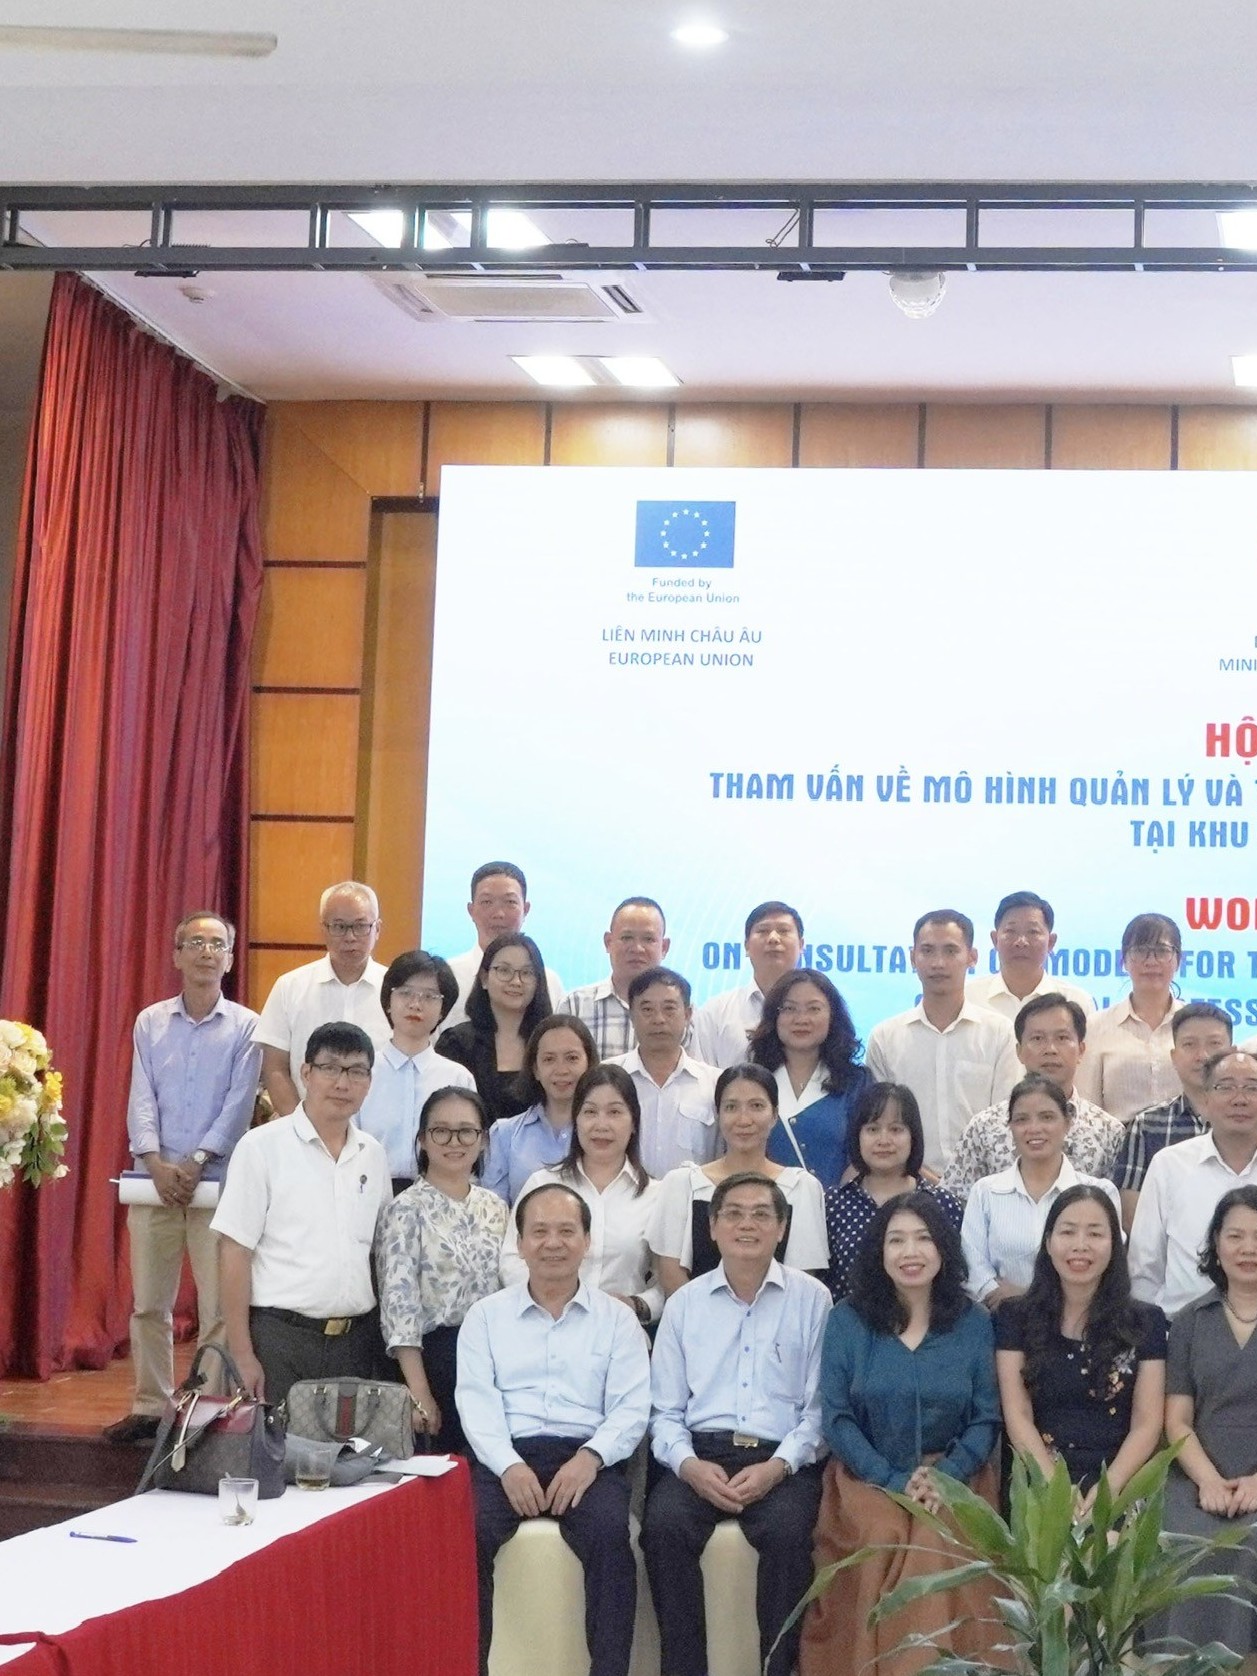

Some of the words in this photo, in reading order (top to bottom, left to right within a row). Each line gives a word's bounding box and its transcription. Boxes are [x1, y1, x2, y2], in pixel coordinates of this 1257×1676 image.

[652, 577, 695, 588] Funded
[698, 578, 712, 590] by
[626, 592, 645, 603] the
[648, 591, 703, 605] European
[706, 592, 740, 604] Union
[602, 625, 635, 642] LIÊN
[641, 629, 685, 643] MINH
[690, 626, 734, 643] CHÂU
[739, 627, 762, 643] ÂU
[609, 652, 695, 666] EUROPEAN
[700, 653, 754, 667] UNION
[710, 772, 795, 800] THAM
[806, 763, 864, 802] VẤN
[876, 765, 911, 803] VỀ
[923, 770, 973, 804] MÔ
[985, 772, 1057, 805] HÌNH
[1069, 769, 1150, 807] QUẢN
[1163, 773, 1195, 807] LÝ
[1205, 773, 1243, 807] VÀ
[1130, 819, 1176, 854] TẠI
[1188, 820, 1249, 849] KHU
[703, 941, 741, 970] ON
[1179, 950, 1236, 979] FOR
